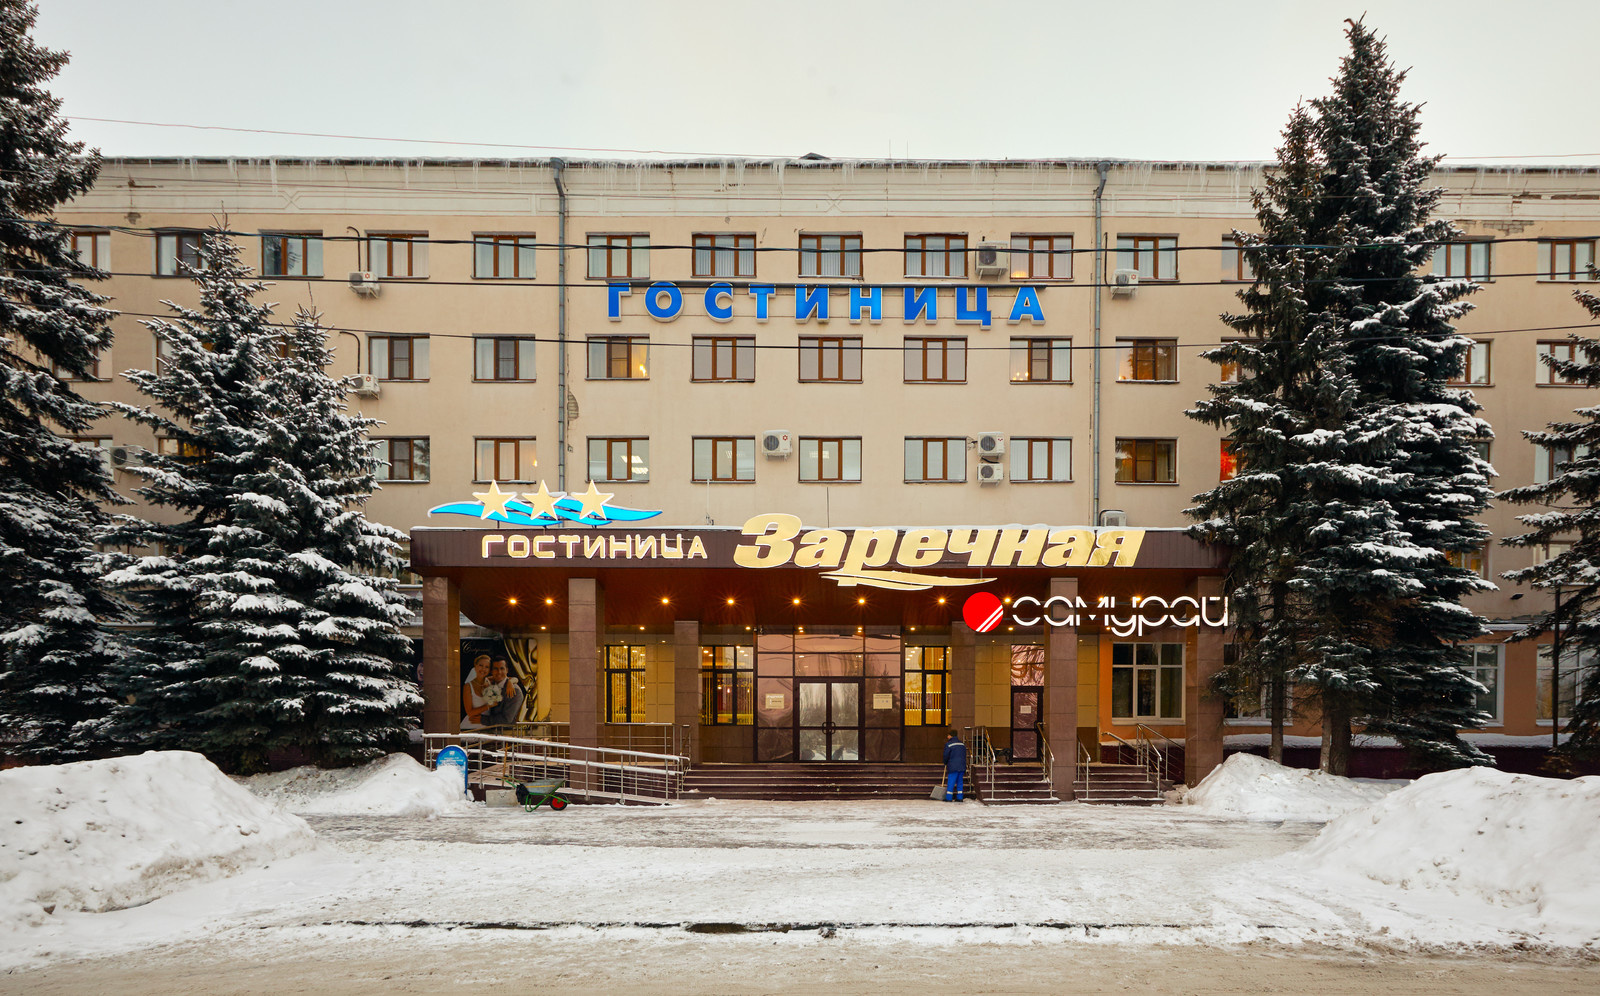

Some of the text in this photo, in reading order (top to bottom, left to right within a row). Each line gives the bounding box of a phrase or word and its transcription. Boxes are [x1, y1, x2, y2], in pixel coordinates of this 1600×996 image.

[607, 281, 1046, 331] ГОСТИНИЦА
[481, 533, 708, 559] ГОСТИНИЦА
[733, 513, 1146, 588] Заречная
